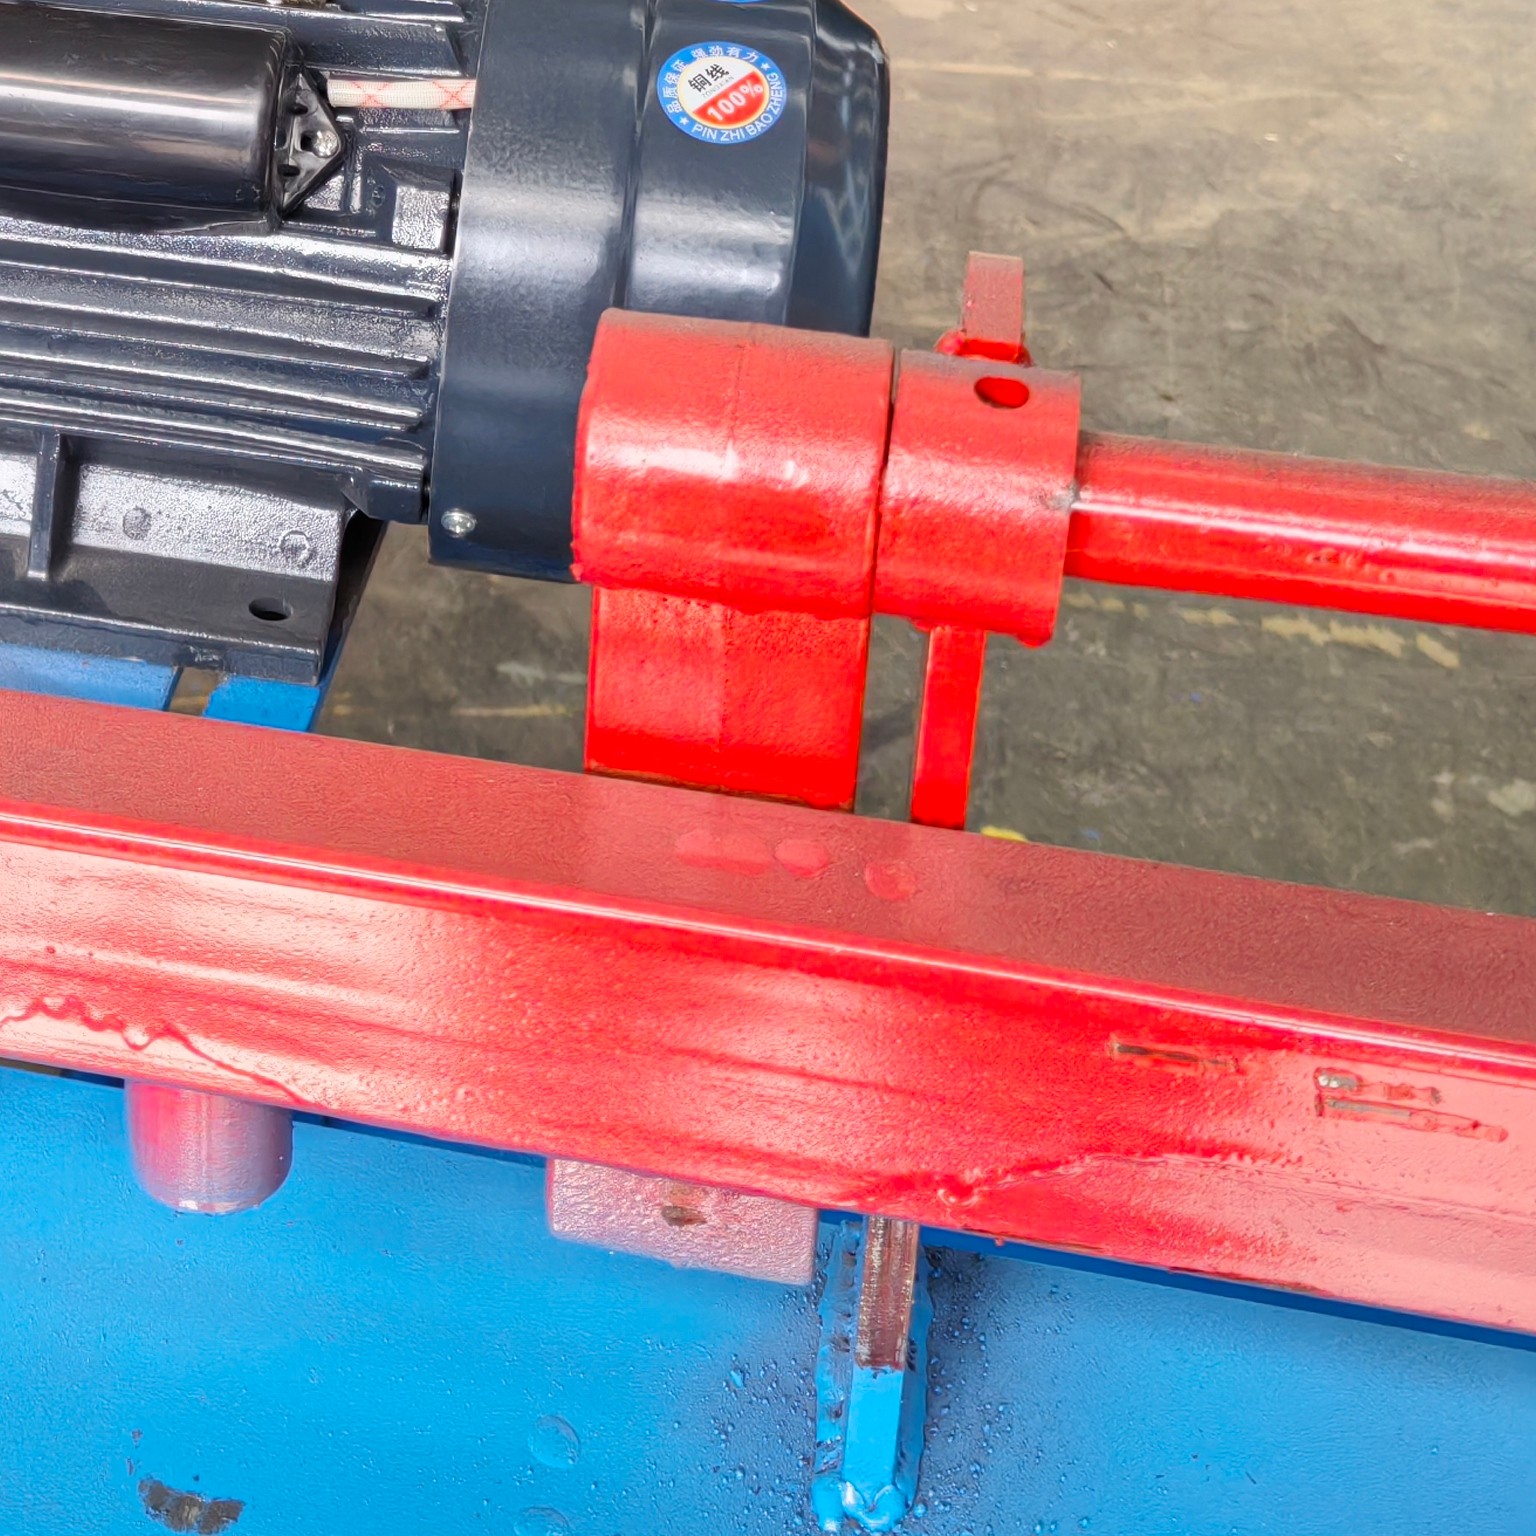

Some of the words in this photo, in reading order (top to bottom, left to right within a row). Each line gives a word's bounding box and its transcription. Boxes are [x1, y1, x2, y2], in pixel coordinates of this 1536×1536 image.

[663, 59, 688, 113] 品质保证
[691, 45, 759, 63] 强劲有力
[688, 64, 729, 92] 铜线
[707, 80, 763, 121] 100%
[691, 123, 717, 139] PIN
[721, 129, 745, 141] ZHI
[745, 114, 773, 136] BAO
[766, 72, 783, 114] ZHENG
